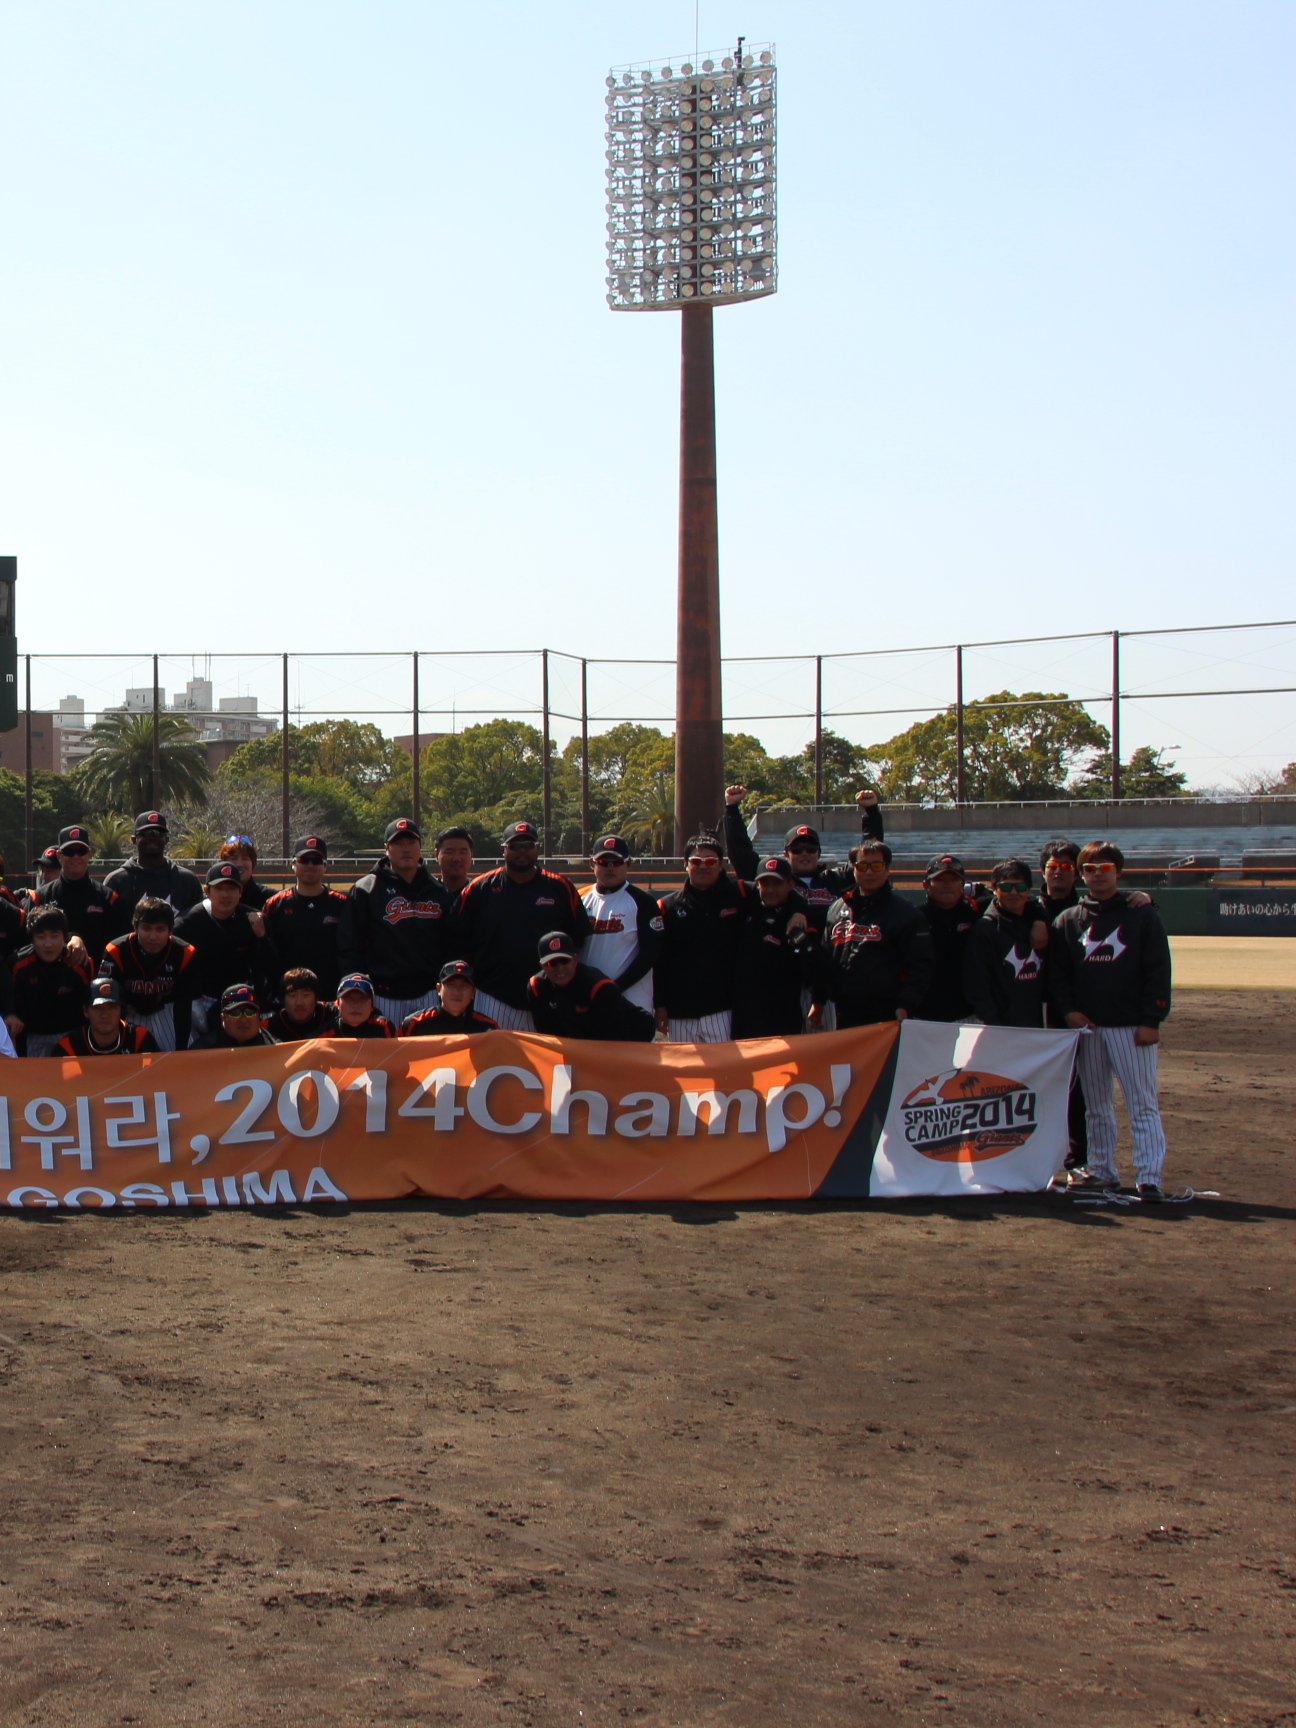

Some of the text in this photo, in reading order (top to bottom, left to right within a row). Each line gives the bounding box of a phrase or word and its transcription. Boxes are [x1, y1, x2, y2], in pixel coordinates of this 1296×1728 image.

[5, 673, 14, 683] m
[1088, 954, 1112, 962] HARD
[904, 1105, 961, 1126] SPRING
[960, 1092, 1036, 1131] 2014
[904, 1120, 960, 1143] CAMP
[972, 1130, 1026, 1152] Giants
